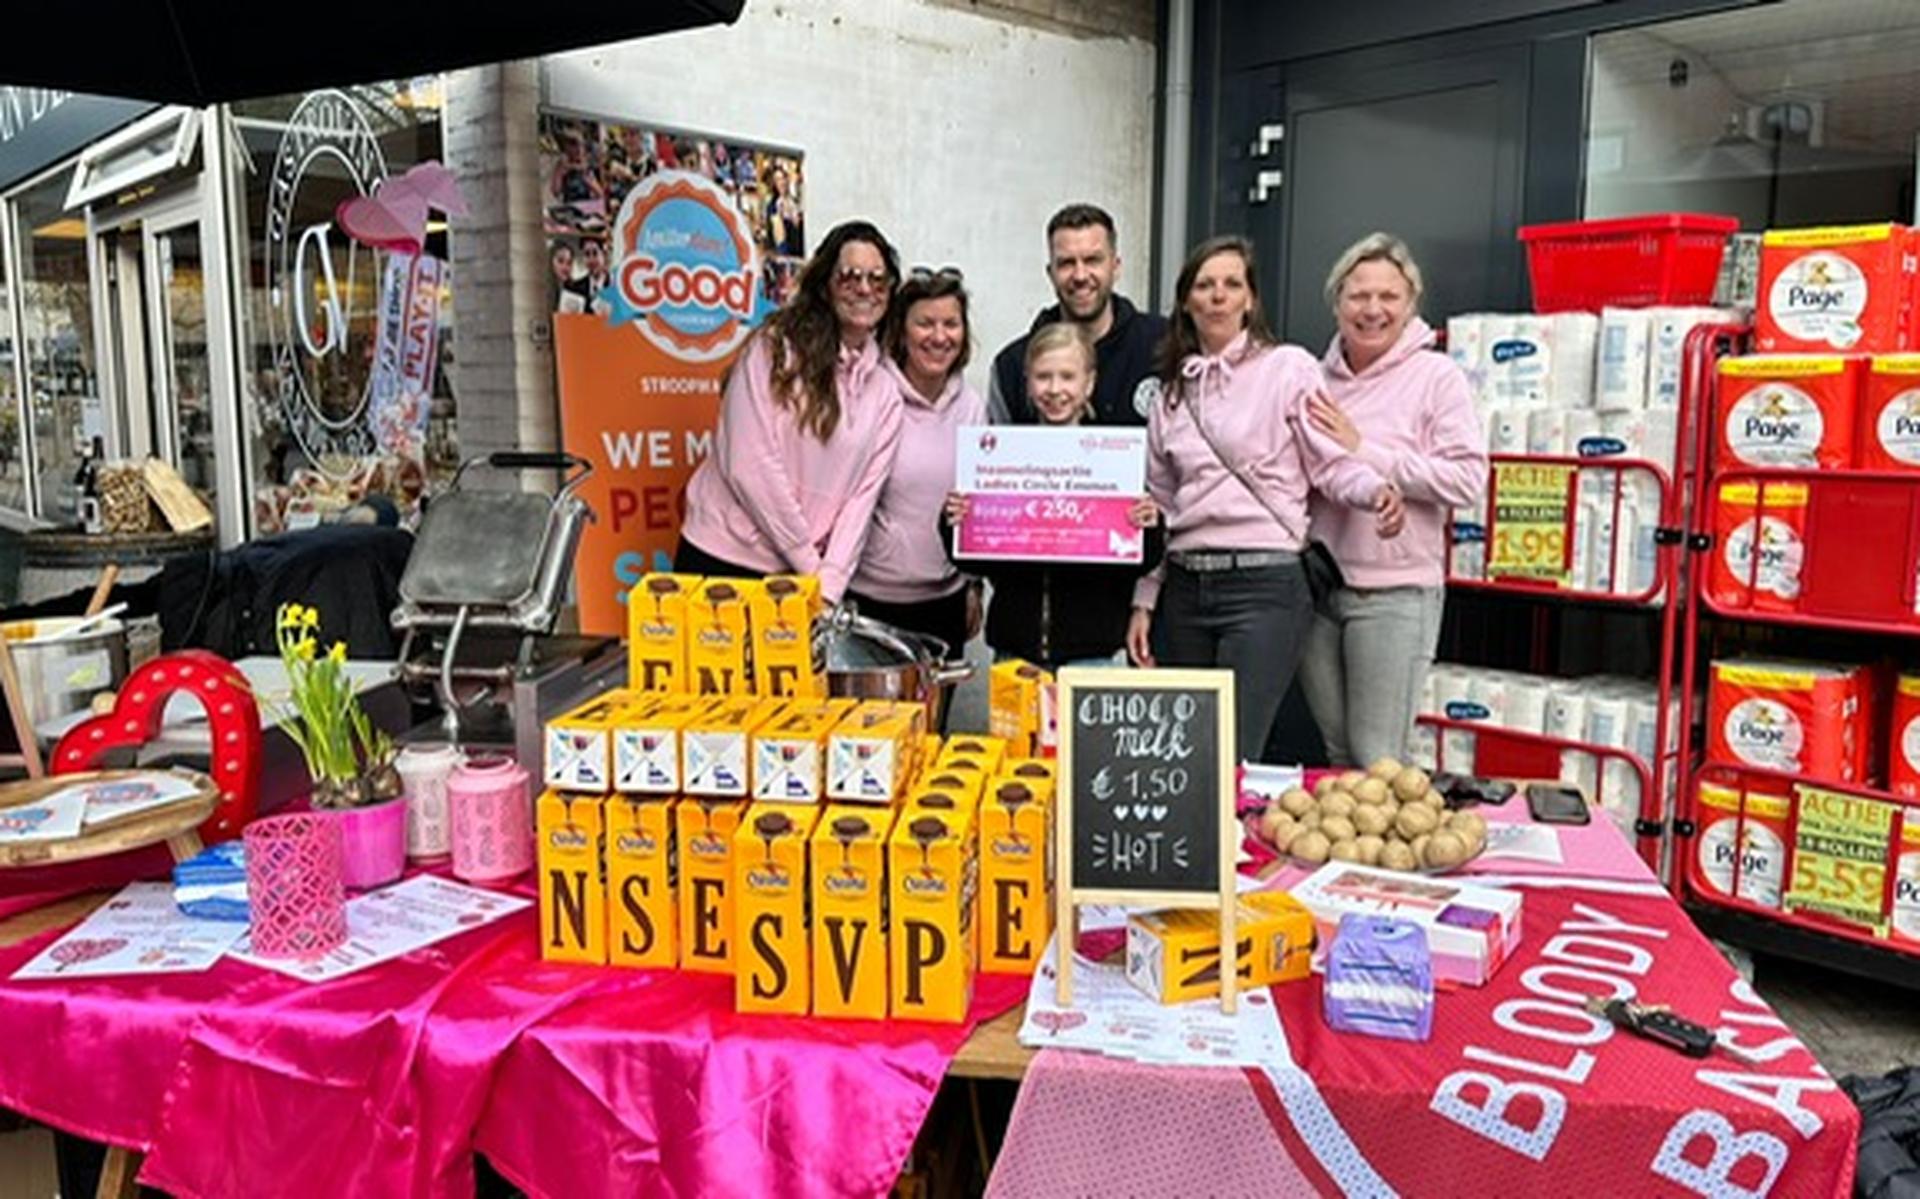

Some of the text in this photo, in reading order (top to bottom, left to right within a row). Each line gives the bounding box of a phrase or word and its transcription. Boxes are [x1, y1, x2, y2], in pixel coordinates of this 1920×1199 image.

[621, 257, 754, 315] Good
[1787, 285, 1845, 312] Page
[601, 431, 674, 470] WE
[1745, 417, 1802, 444] Page
[1022, 479, 1061, 492] Circle
[1064, 480, 1119, 492] Emmen
[1024, 501, 1039, 519] €
[613, 550, 673, 604] S
[1078, 692, 1197, 725] CHOCO
[1738, 721, 1785, 746] Page
[1090, 765, 1116, 800] €
[1803, 792, 1889, 828] ACTIE!
[549, 869, 588, 950] N
[620, 874, 654, 955] S
[692, 877, 727, 960] E
[993, 877, 1032, 961] E
[750, 912, 788, 1001] S
[823, 916, 868, 1005] V
[903, 917, 947, 1006] P
[1179, 936, 1253, 988] N
[1429, 903, 1669, 1163] BLOODY
